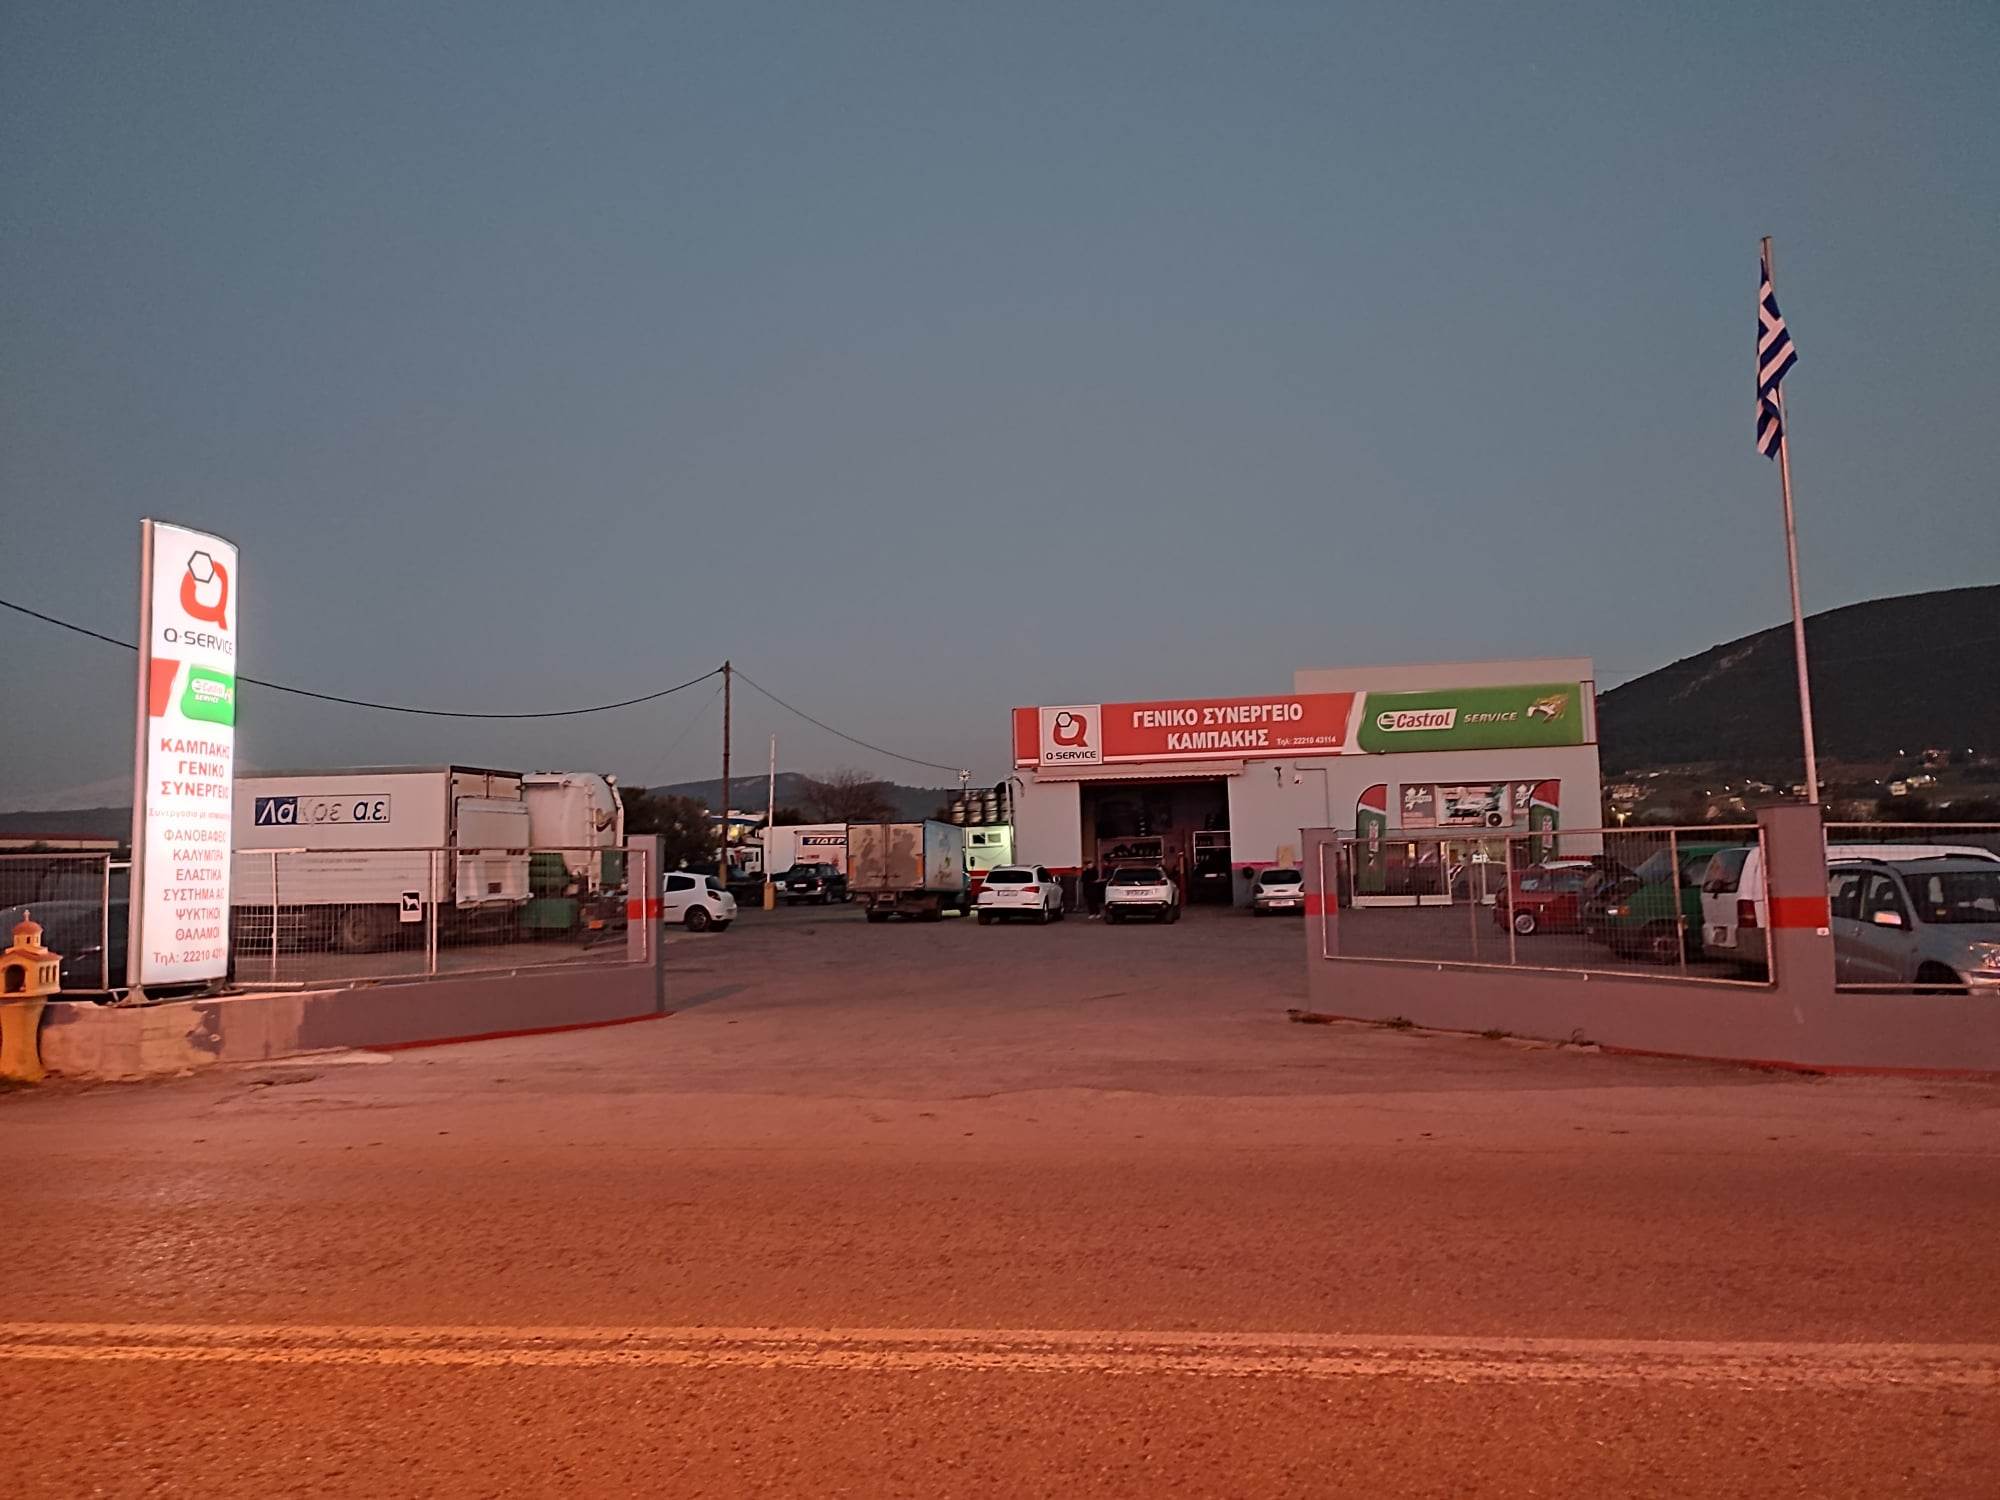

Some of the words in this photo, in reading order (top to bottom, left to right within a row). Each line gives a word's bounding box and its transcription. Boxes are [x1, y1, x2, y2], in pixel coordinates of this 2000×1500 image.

[1133, 709, 1198, 729] ΓΕΝΙΚΟ
[1203, 703, 1304, 726] ΣΥΝΕΡΓΕΙΟ
[1396, 711, 1451, 730] Castrol
[1463, 711, 1519, 724] SERVICE
[1167, 728, 1270, 750] ΚΑΜΠΑΚΗΣ
[178, 760, 225, 778] ΓΕΝΙΚΟ
[183, 949, 210, 963] 22210
